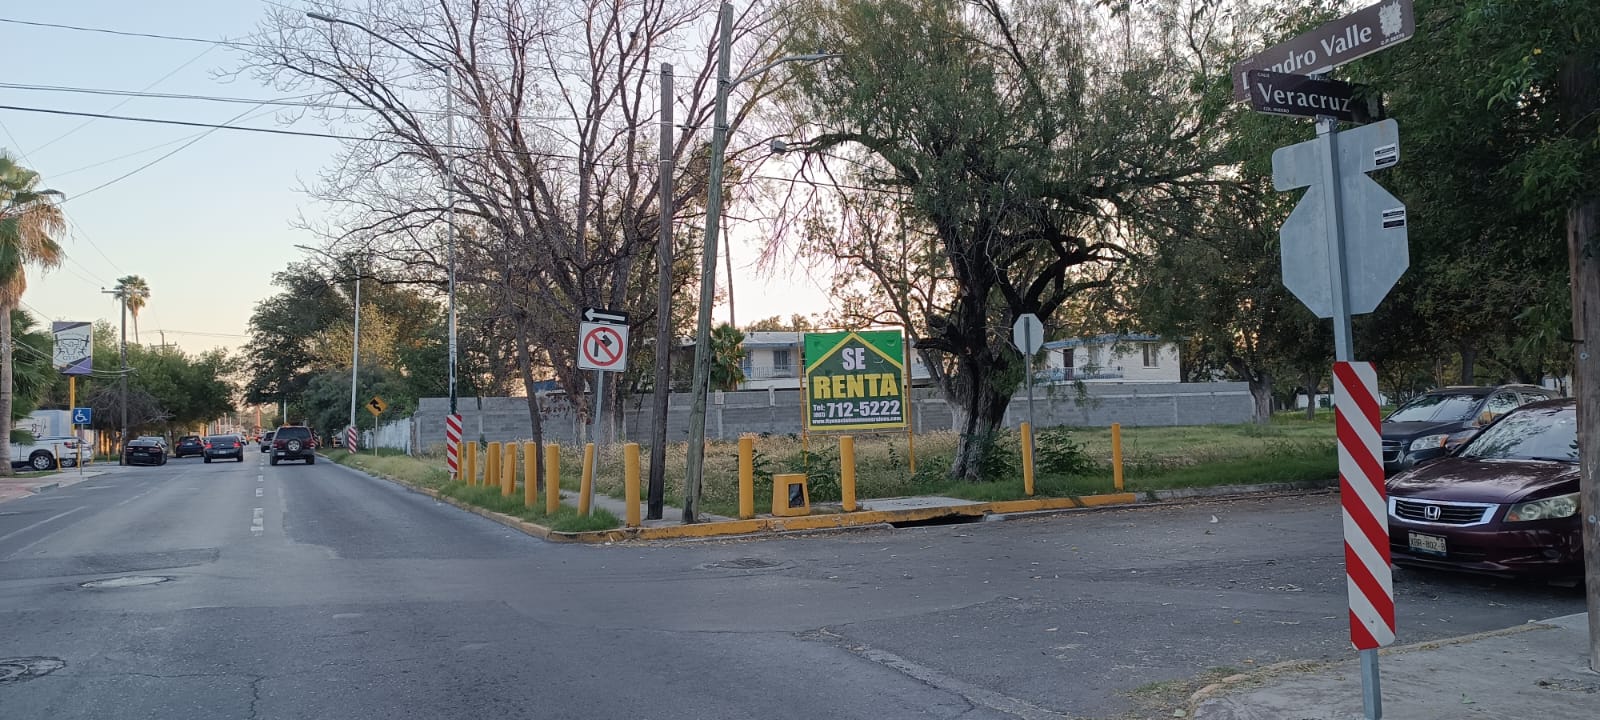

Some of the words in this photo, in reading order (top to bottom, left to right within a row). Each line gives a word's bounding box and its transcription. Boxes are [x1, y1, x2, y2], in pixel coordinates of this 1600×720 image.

[1242, 49, 1317, 90] Lndro
[1321, 23, 1372, 57] Valle
[1257, 82, 1352, 113] Veracruz
[842, 348, 866, 371] SE
[813, 373, 899, 400] RENTA
[812, 403, 826, 411] Tel:
[827, 400, 901, 418] 712-5222
